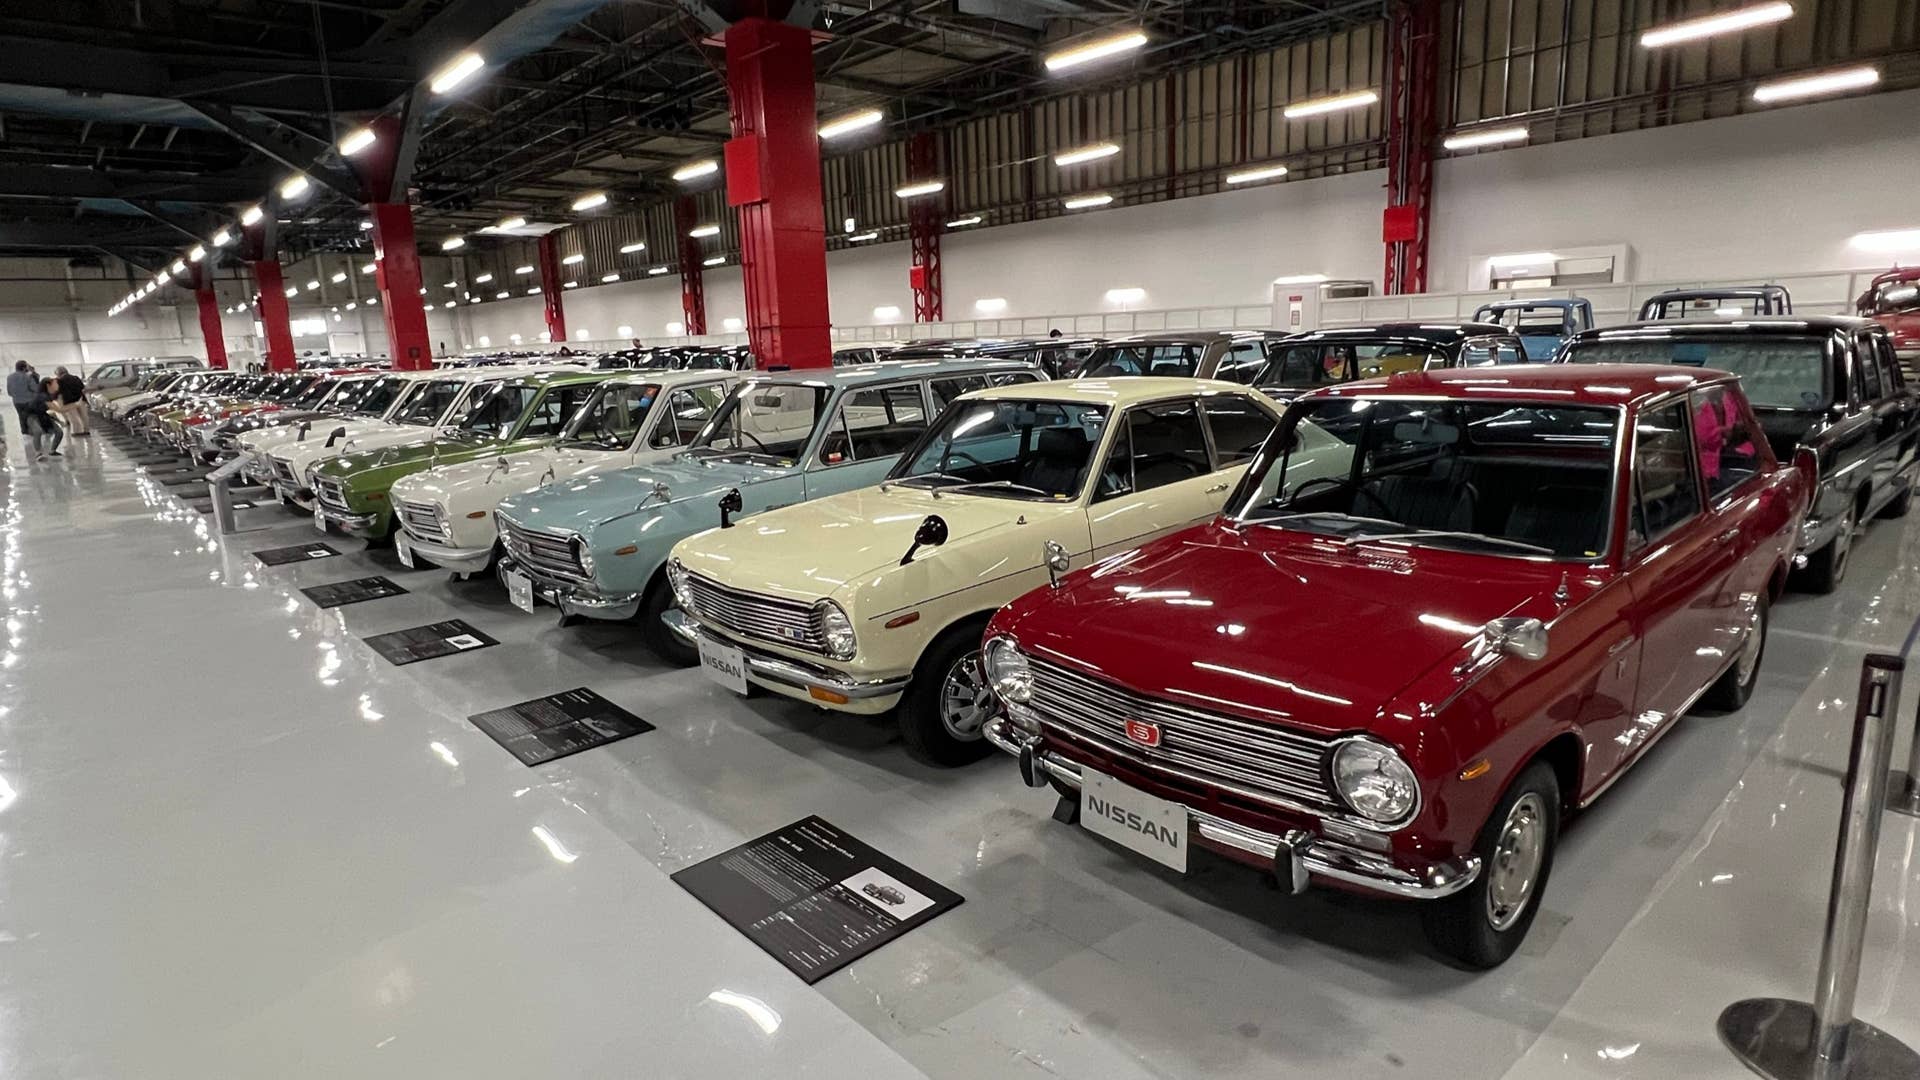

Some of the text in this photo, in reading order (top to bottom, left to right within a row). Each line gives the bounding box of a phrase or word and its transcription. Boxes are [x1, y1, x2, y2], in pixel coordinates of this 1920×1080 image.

[702, 652, 742, 679] NISSAN
[1132, 725, 1150, 740] S
[1088, 794, 1178, 849] NISSAN
